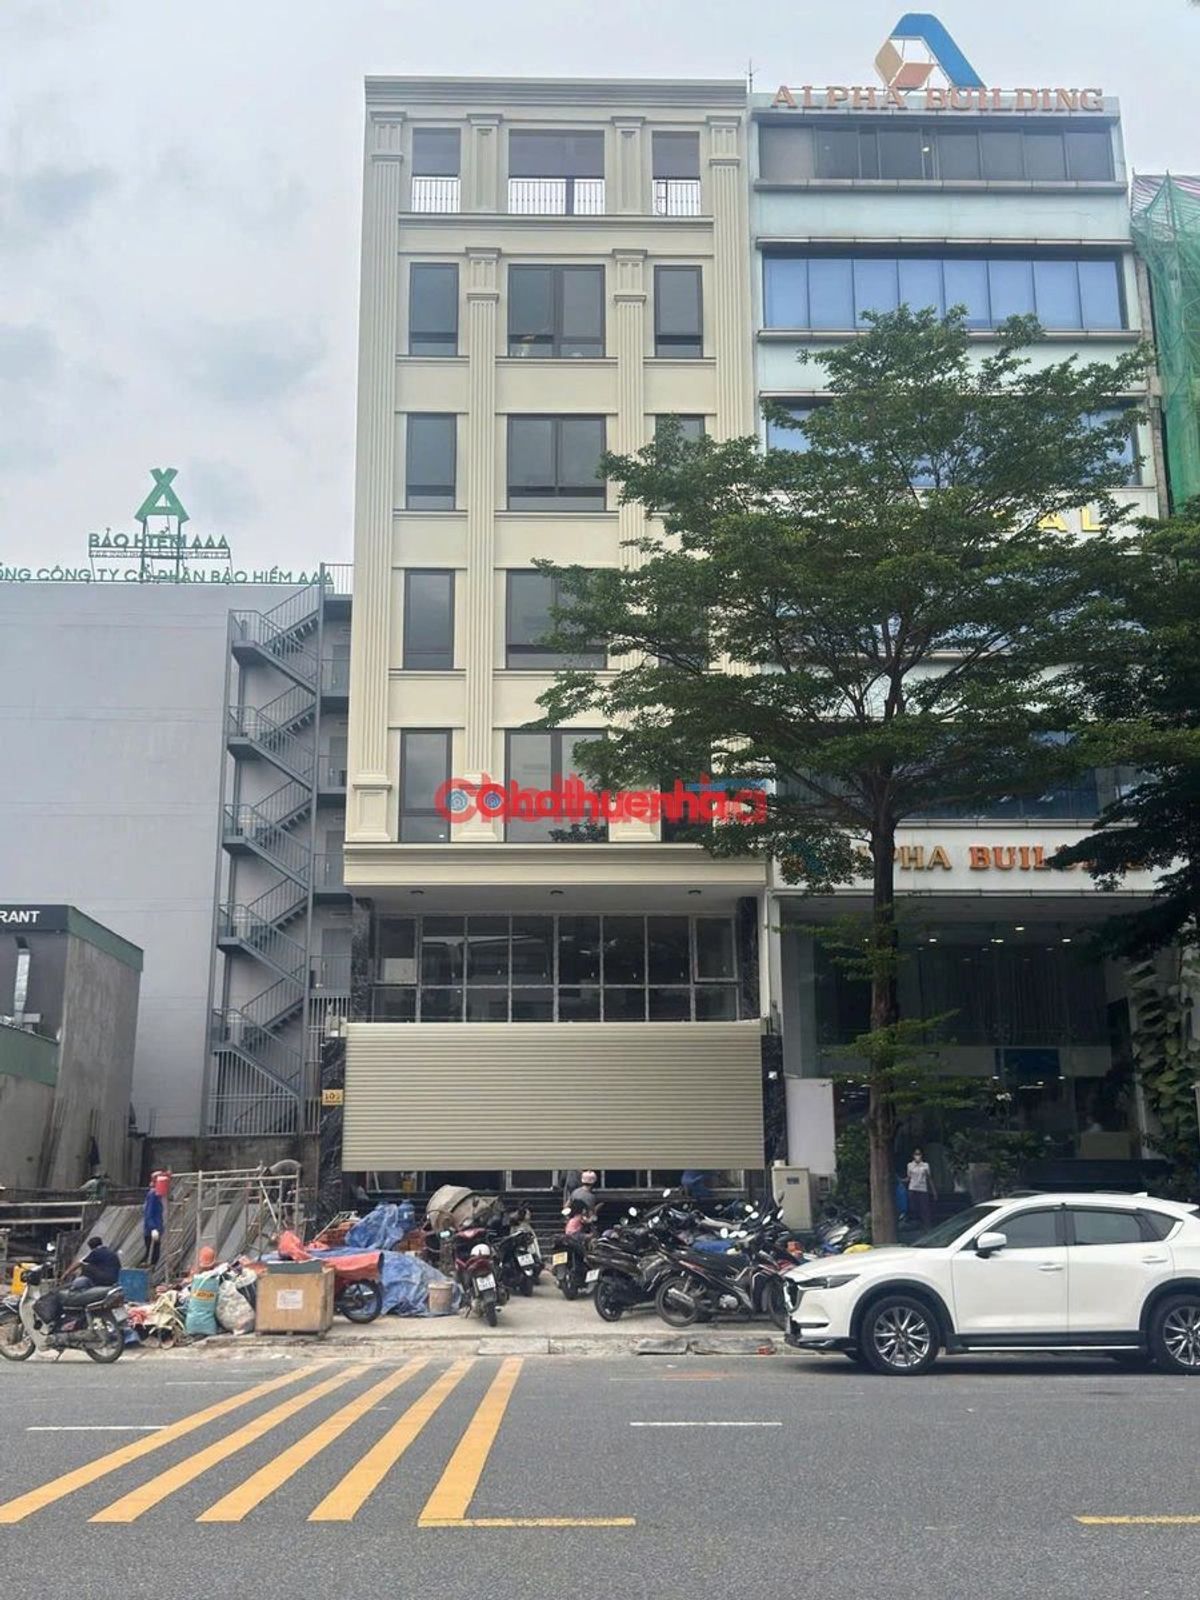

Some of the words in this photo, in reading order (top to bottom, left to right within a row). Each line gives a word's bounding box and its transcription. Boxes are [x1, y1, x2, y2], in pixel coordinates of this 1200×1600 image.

[770, 85, 908, 110] ALPHA
[924, 88, 1104, 112] BUILDING
[88, 527, 129, 549] BẢO
[37, 565, 91, 582] CÔNG
[97, 568, 119, 582] TY
[211, 566, 247, 583] BẢO
